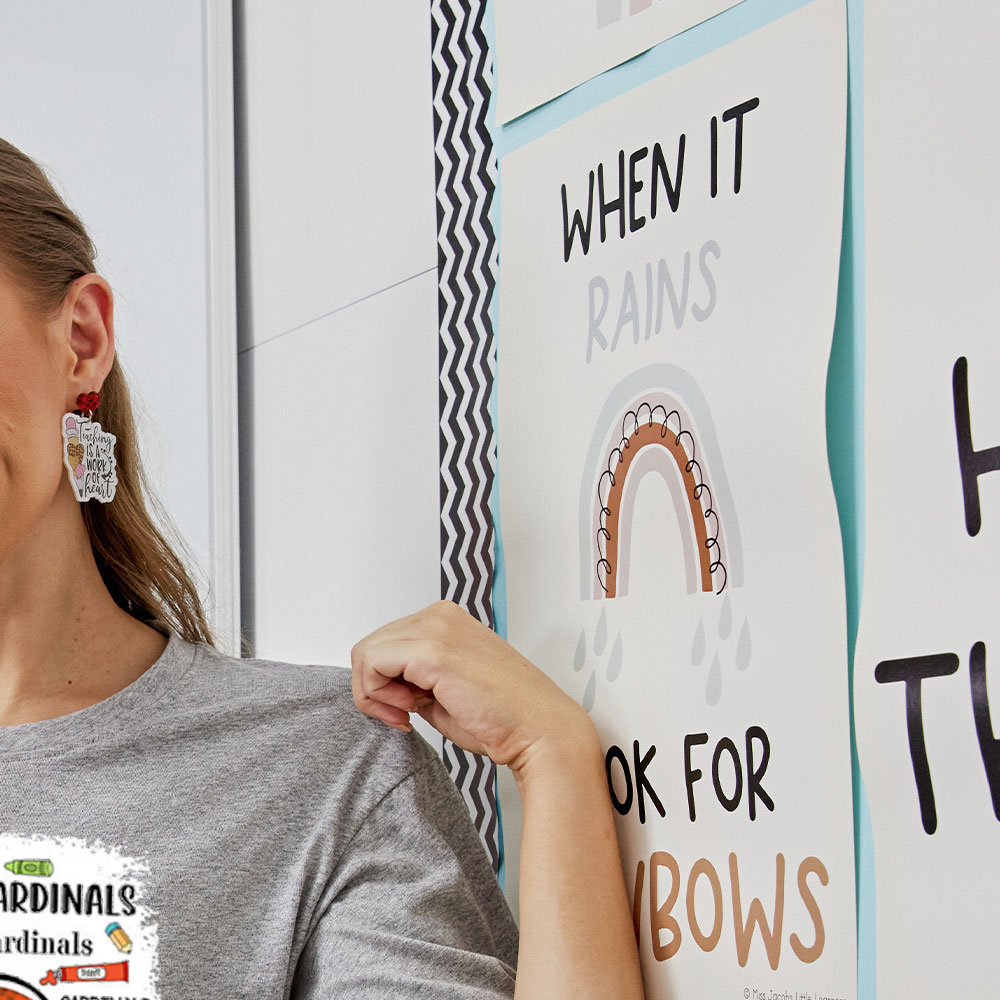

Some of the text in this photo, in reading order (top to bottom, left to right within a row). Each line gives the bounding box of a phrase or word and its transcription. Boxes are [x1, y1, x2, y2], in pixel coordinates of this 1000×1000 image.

[561, 97, 760, 262] WHEN IT
[586, 240, 721, 364] RAINS
[76, 417, 113, 454] Teaching
[86, 459, 106, 472] WORK
[85, 472, 114, 498] heart
[684, 726, 775, 822] FOR
[752, 988, 766, 1000] Miss
